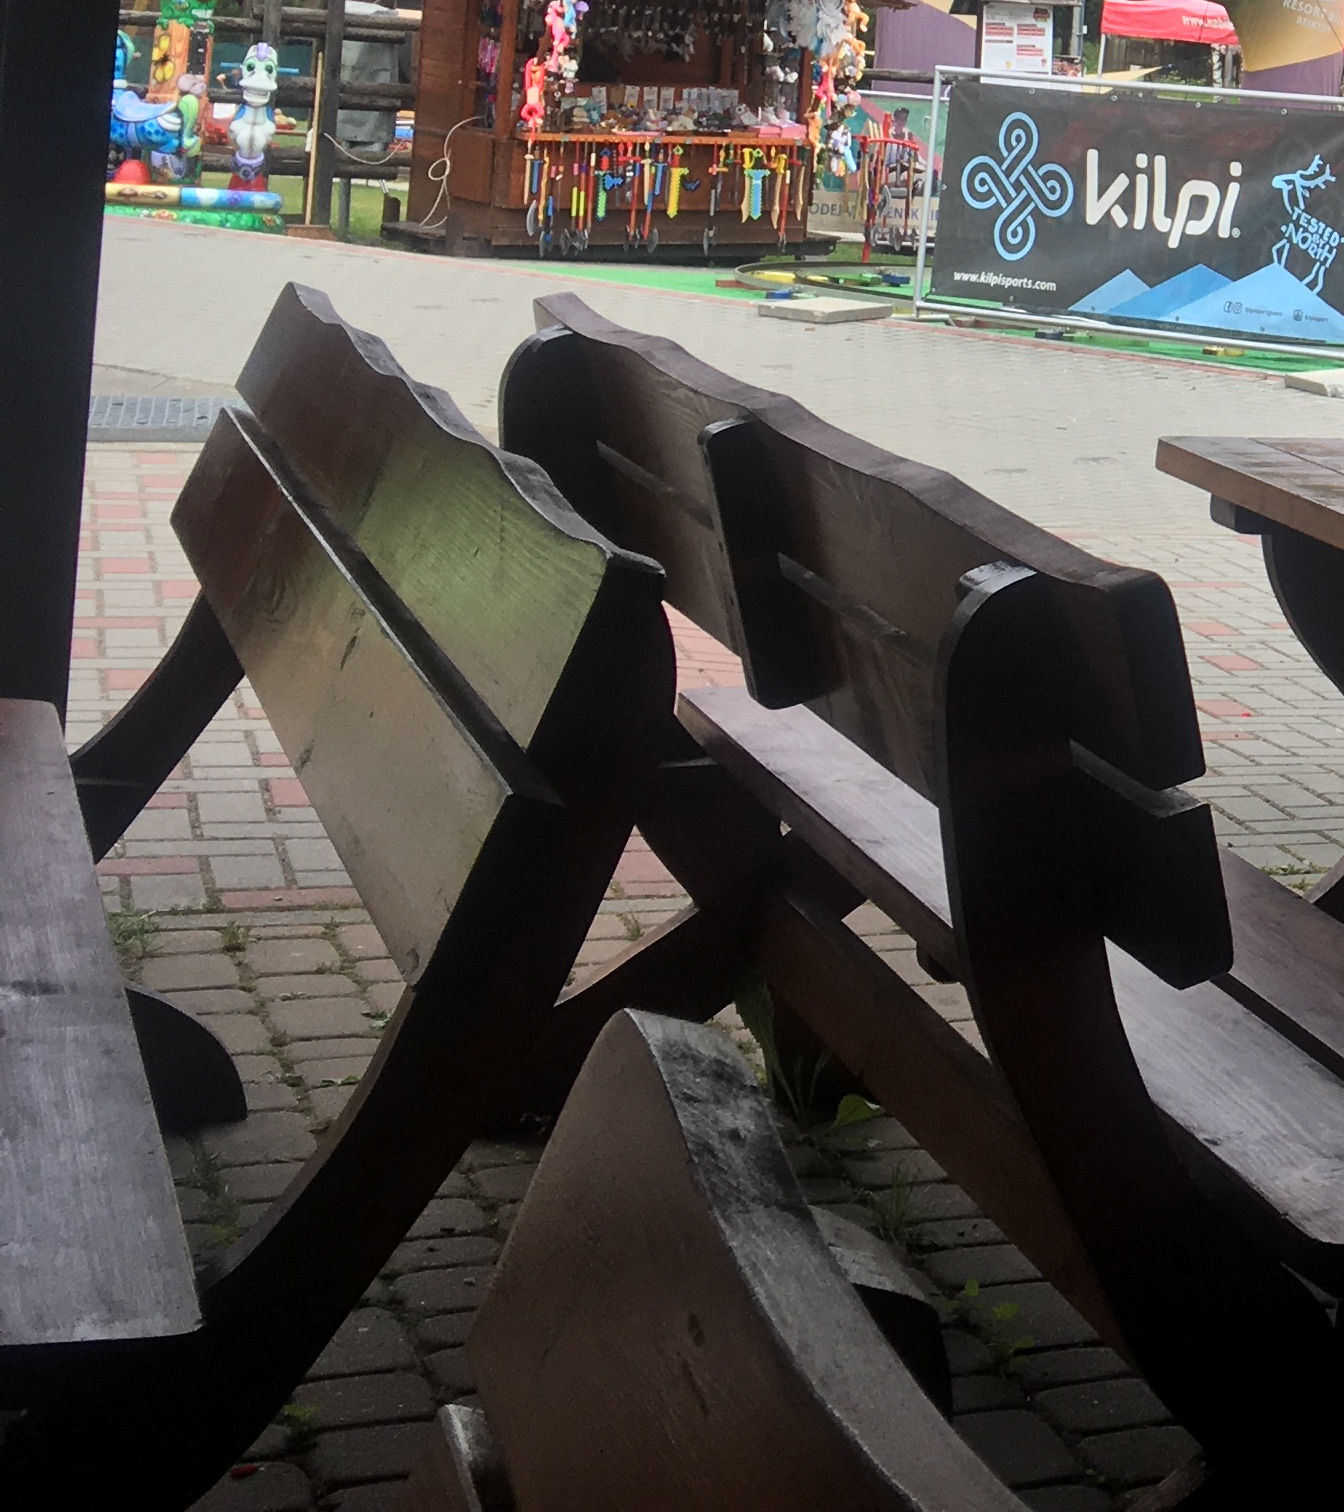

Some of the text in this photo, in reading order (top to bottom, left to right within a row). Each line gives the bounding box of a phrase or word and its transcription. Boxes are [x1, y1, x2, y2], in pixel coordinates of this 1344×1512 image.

[1086, 148, 1242, 249] kilpi
[1284, 223, 1337, 268] NORTH
[1292, 206, 1340, 247] TESTED
[953, 271, 1057, 291] www.kilpisports.com
